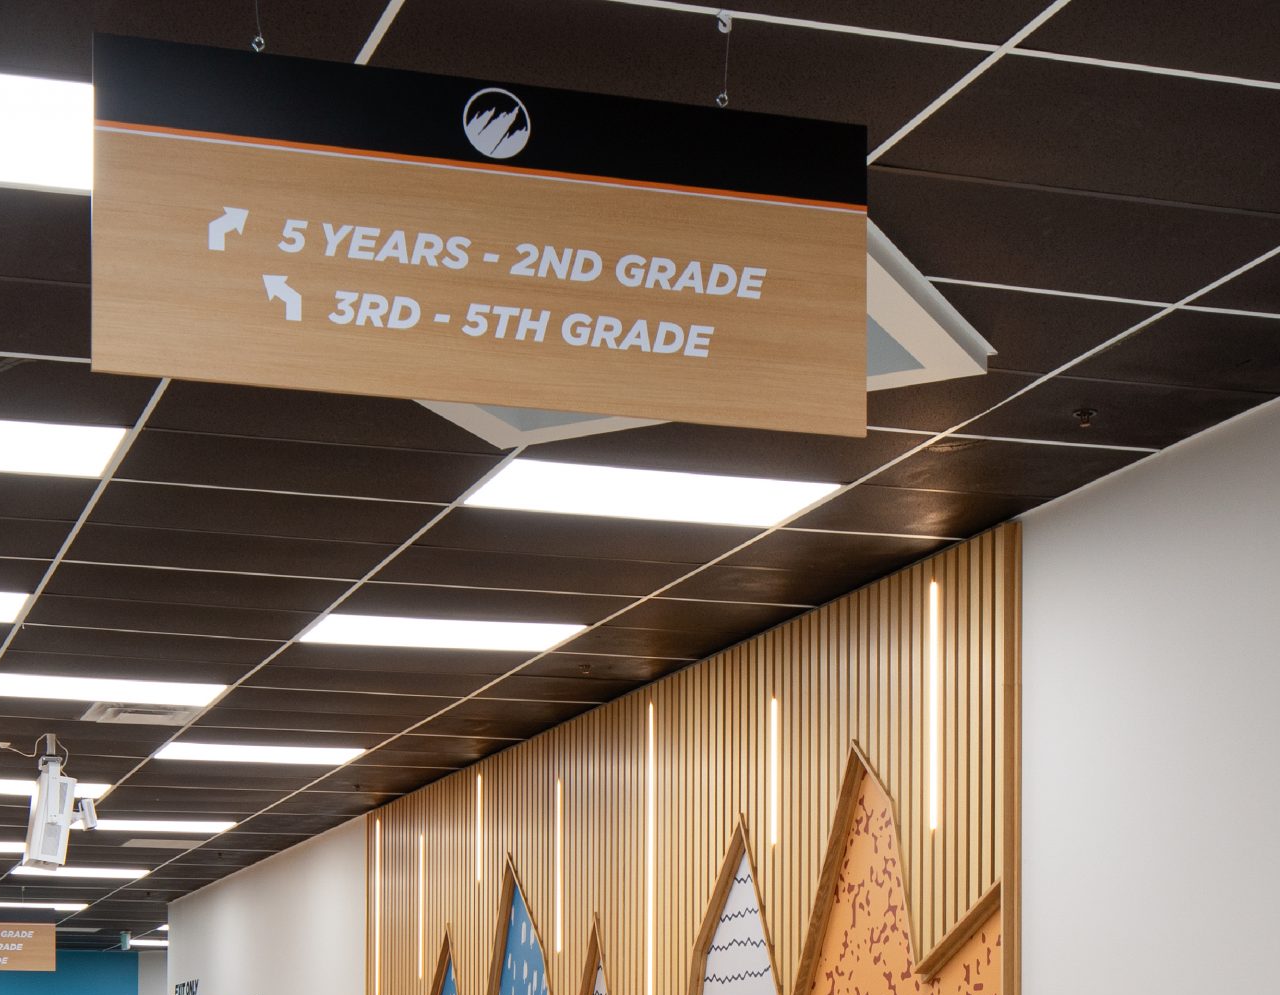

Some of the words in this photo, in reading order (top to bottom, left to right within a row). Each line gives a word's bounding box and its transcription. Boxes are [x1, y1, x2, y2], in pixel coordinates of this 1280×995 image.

[277, 219, 308, 253] 5
[322, 222, 472, 270] YEARS
[483, 252, 499, 263] -
[510, 243, 603, 283] 2ND
[615, 254, 767, 299] GRADE
[328, 290, 422, 329] 3RD
[433, 313, 451, 323] -
[462, 303, 552, 343] 5TH
[561, 313, 715, 358] GRADE
[0, 930, 34, 938] GRADE
